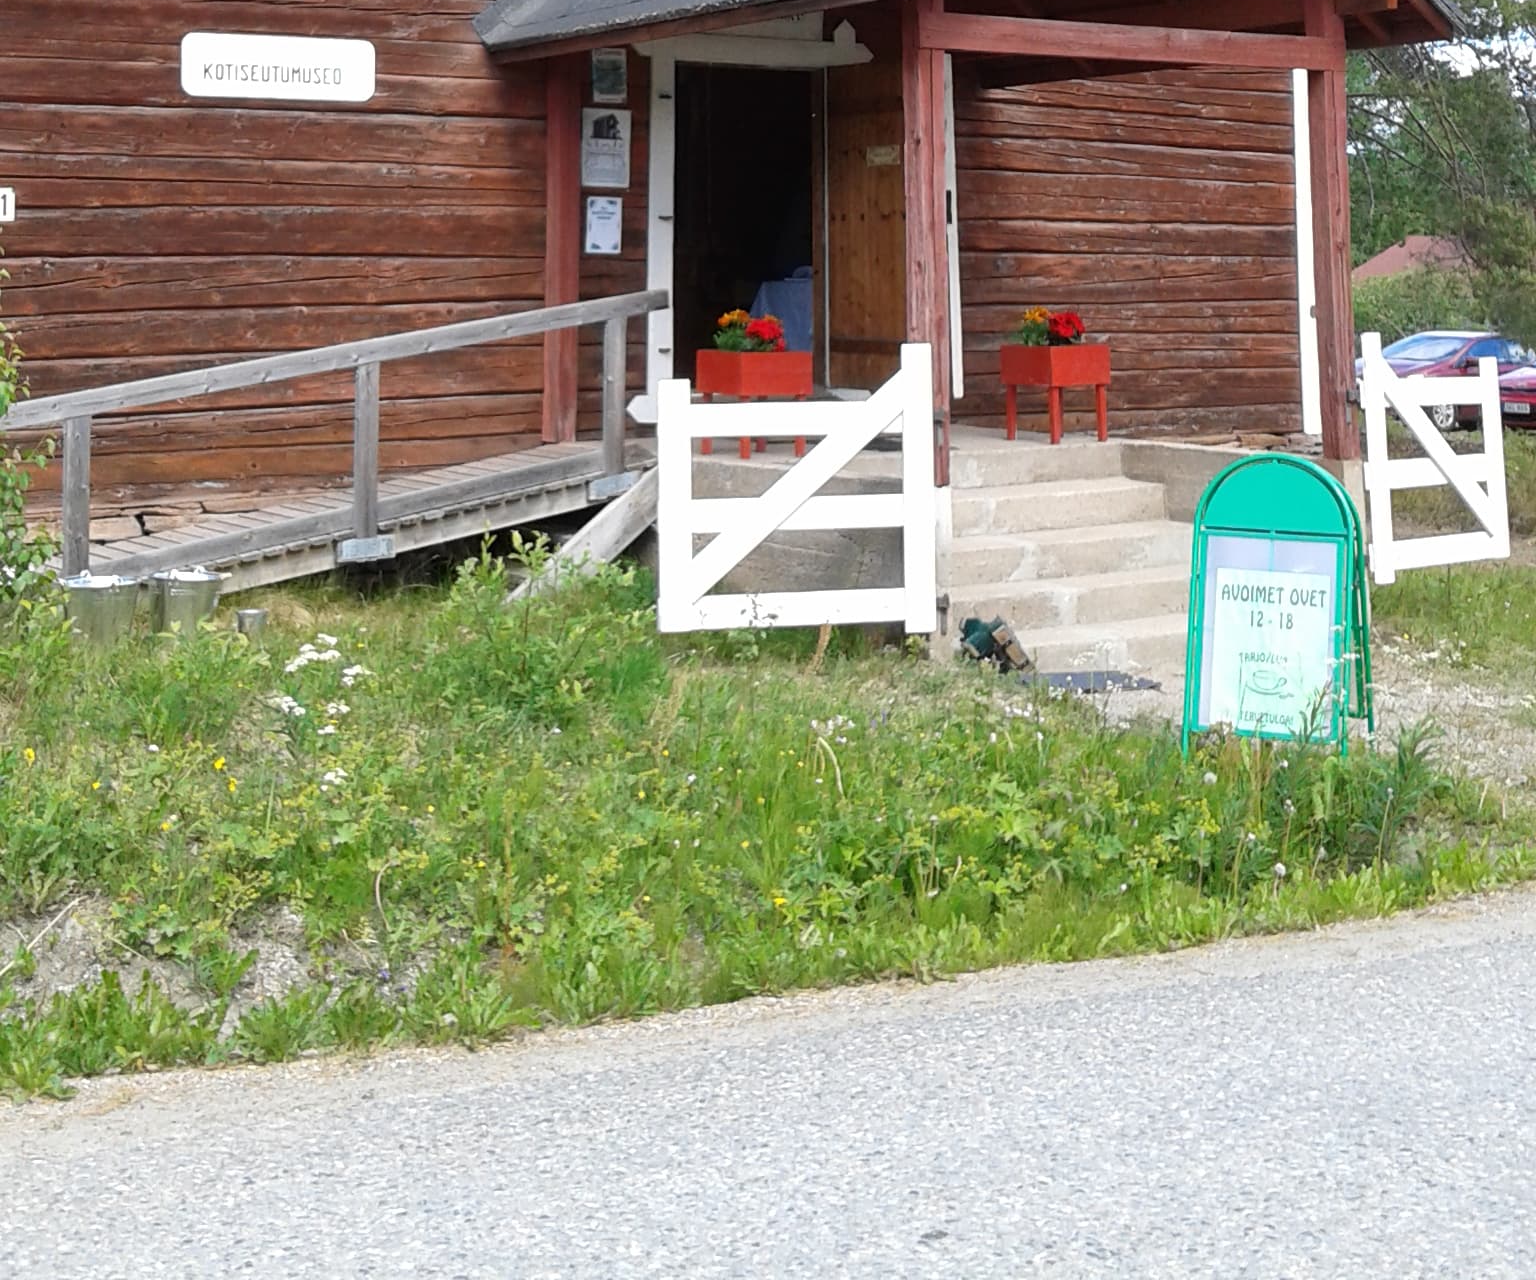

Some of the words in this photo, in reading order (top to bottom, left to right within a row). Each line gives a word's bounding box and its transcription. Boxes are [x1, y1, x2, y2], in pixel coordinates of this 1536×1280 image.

[203, 63, 342, 85] KOTISEUTUMUSEO
[1221, 583, 1285, 605] AVOIMET
[1289, 588, 1327, 608] OVET
